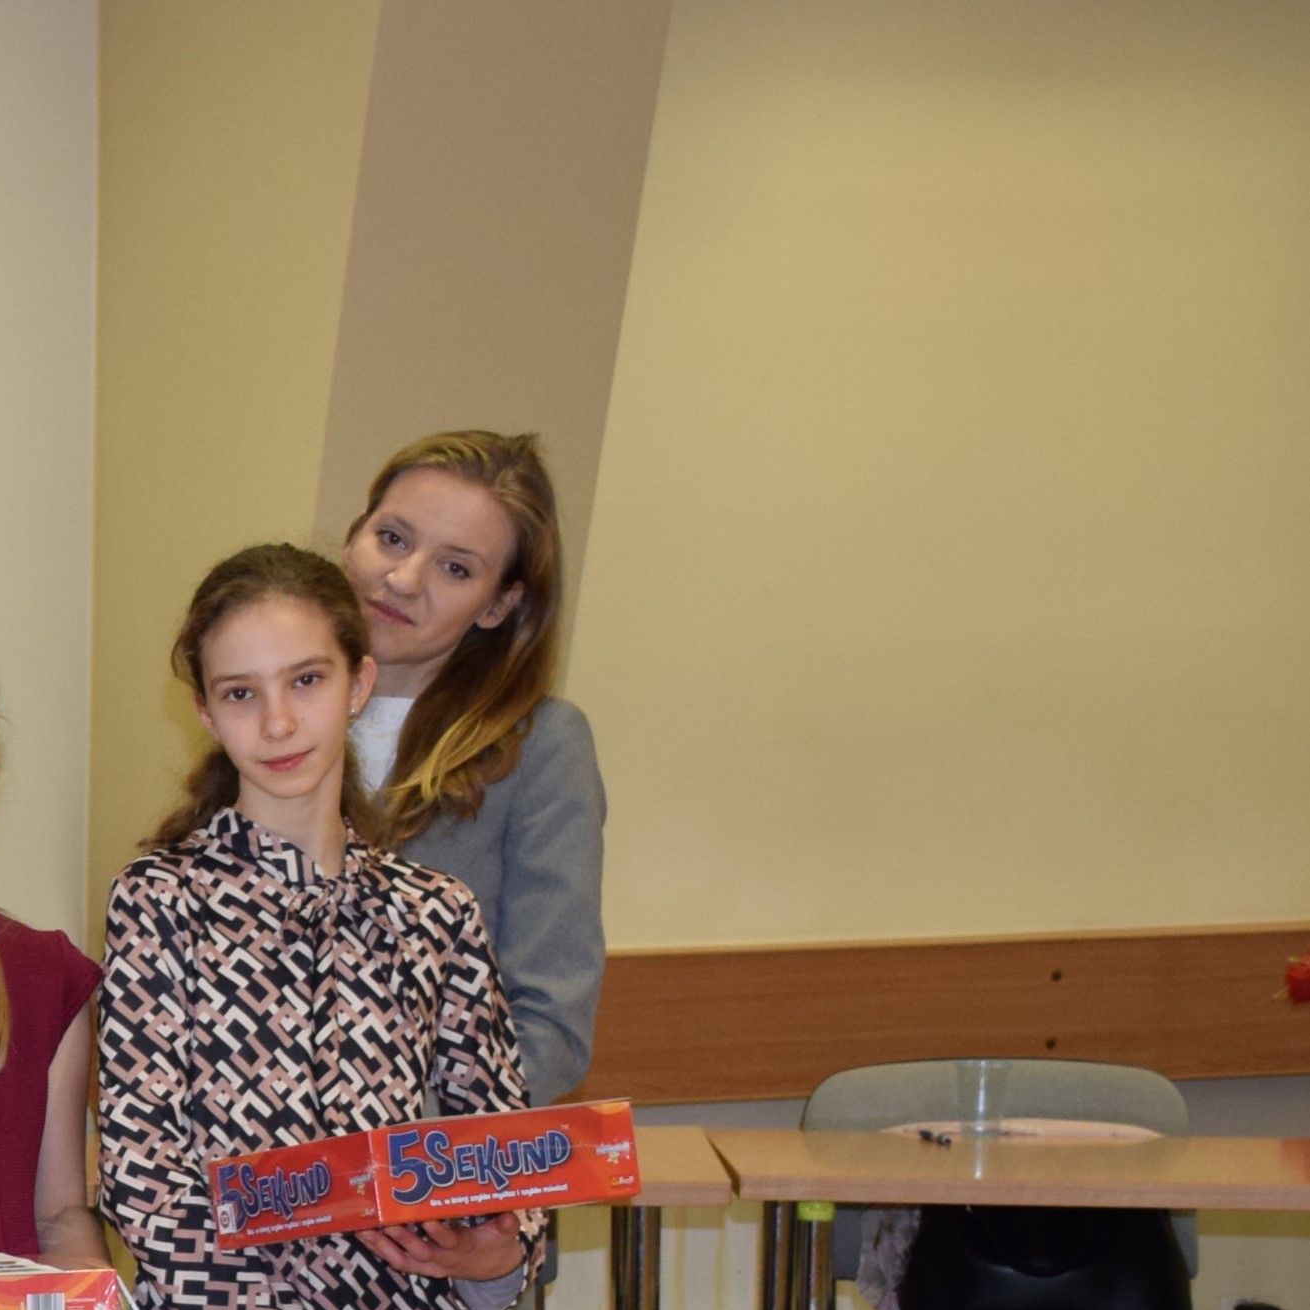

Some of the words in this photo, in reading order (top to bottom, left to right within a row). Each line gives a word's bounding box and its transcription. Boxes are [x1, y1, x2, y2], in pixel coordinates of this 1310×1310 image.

[217, 1164, 248, 1232] 5
[239, 1162, 330, 1220] SEKUND
[388, 1129, 433, 1205] 5
[424, 1130, 571, 1190] SEKUND
